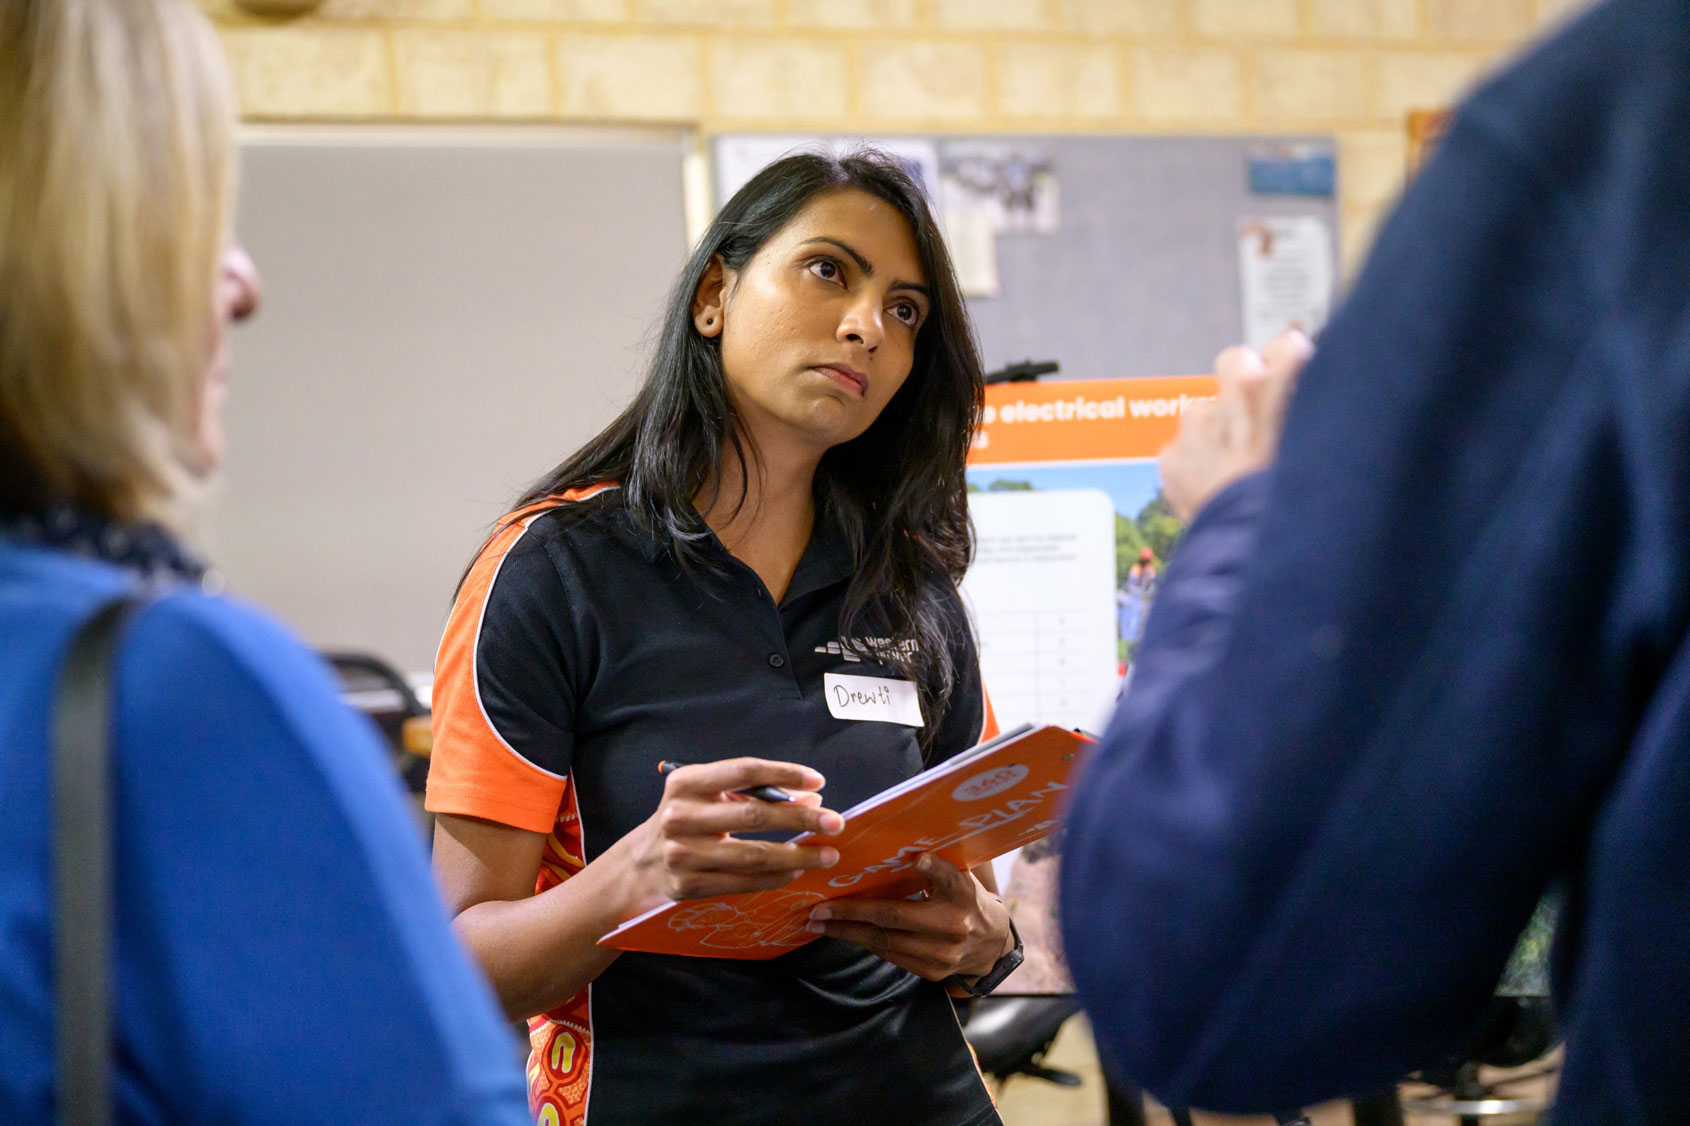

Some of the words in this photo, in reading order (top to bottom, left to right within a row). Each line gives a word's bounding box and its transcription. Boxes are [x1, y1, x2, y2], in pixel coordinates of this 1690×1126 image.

[1000, 396, 1125, 424] electrical
[828, 837, 957, 888] GAME
[958, 781, 1069, 828] PLAN
